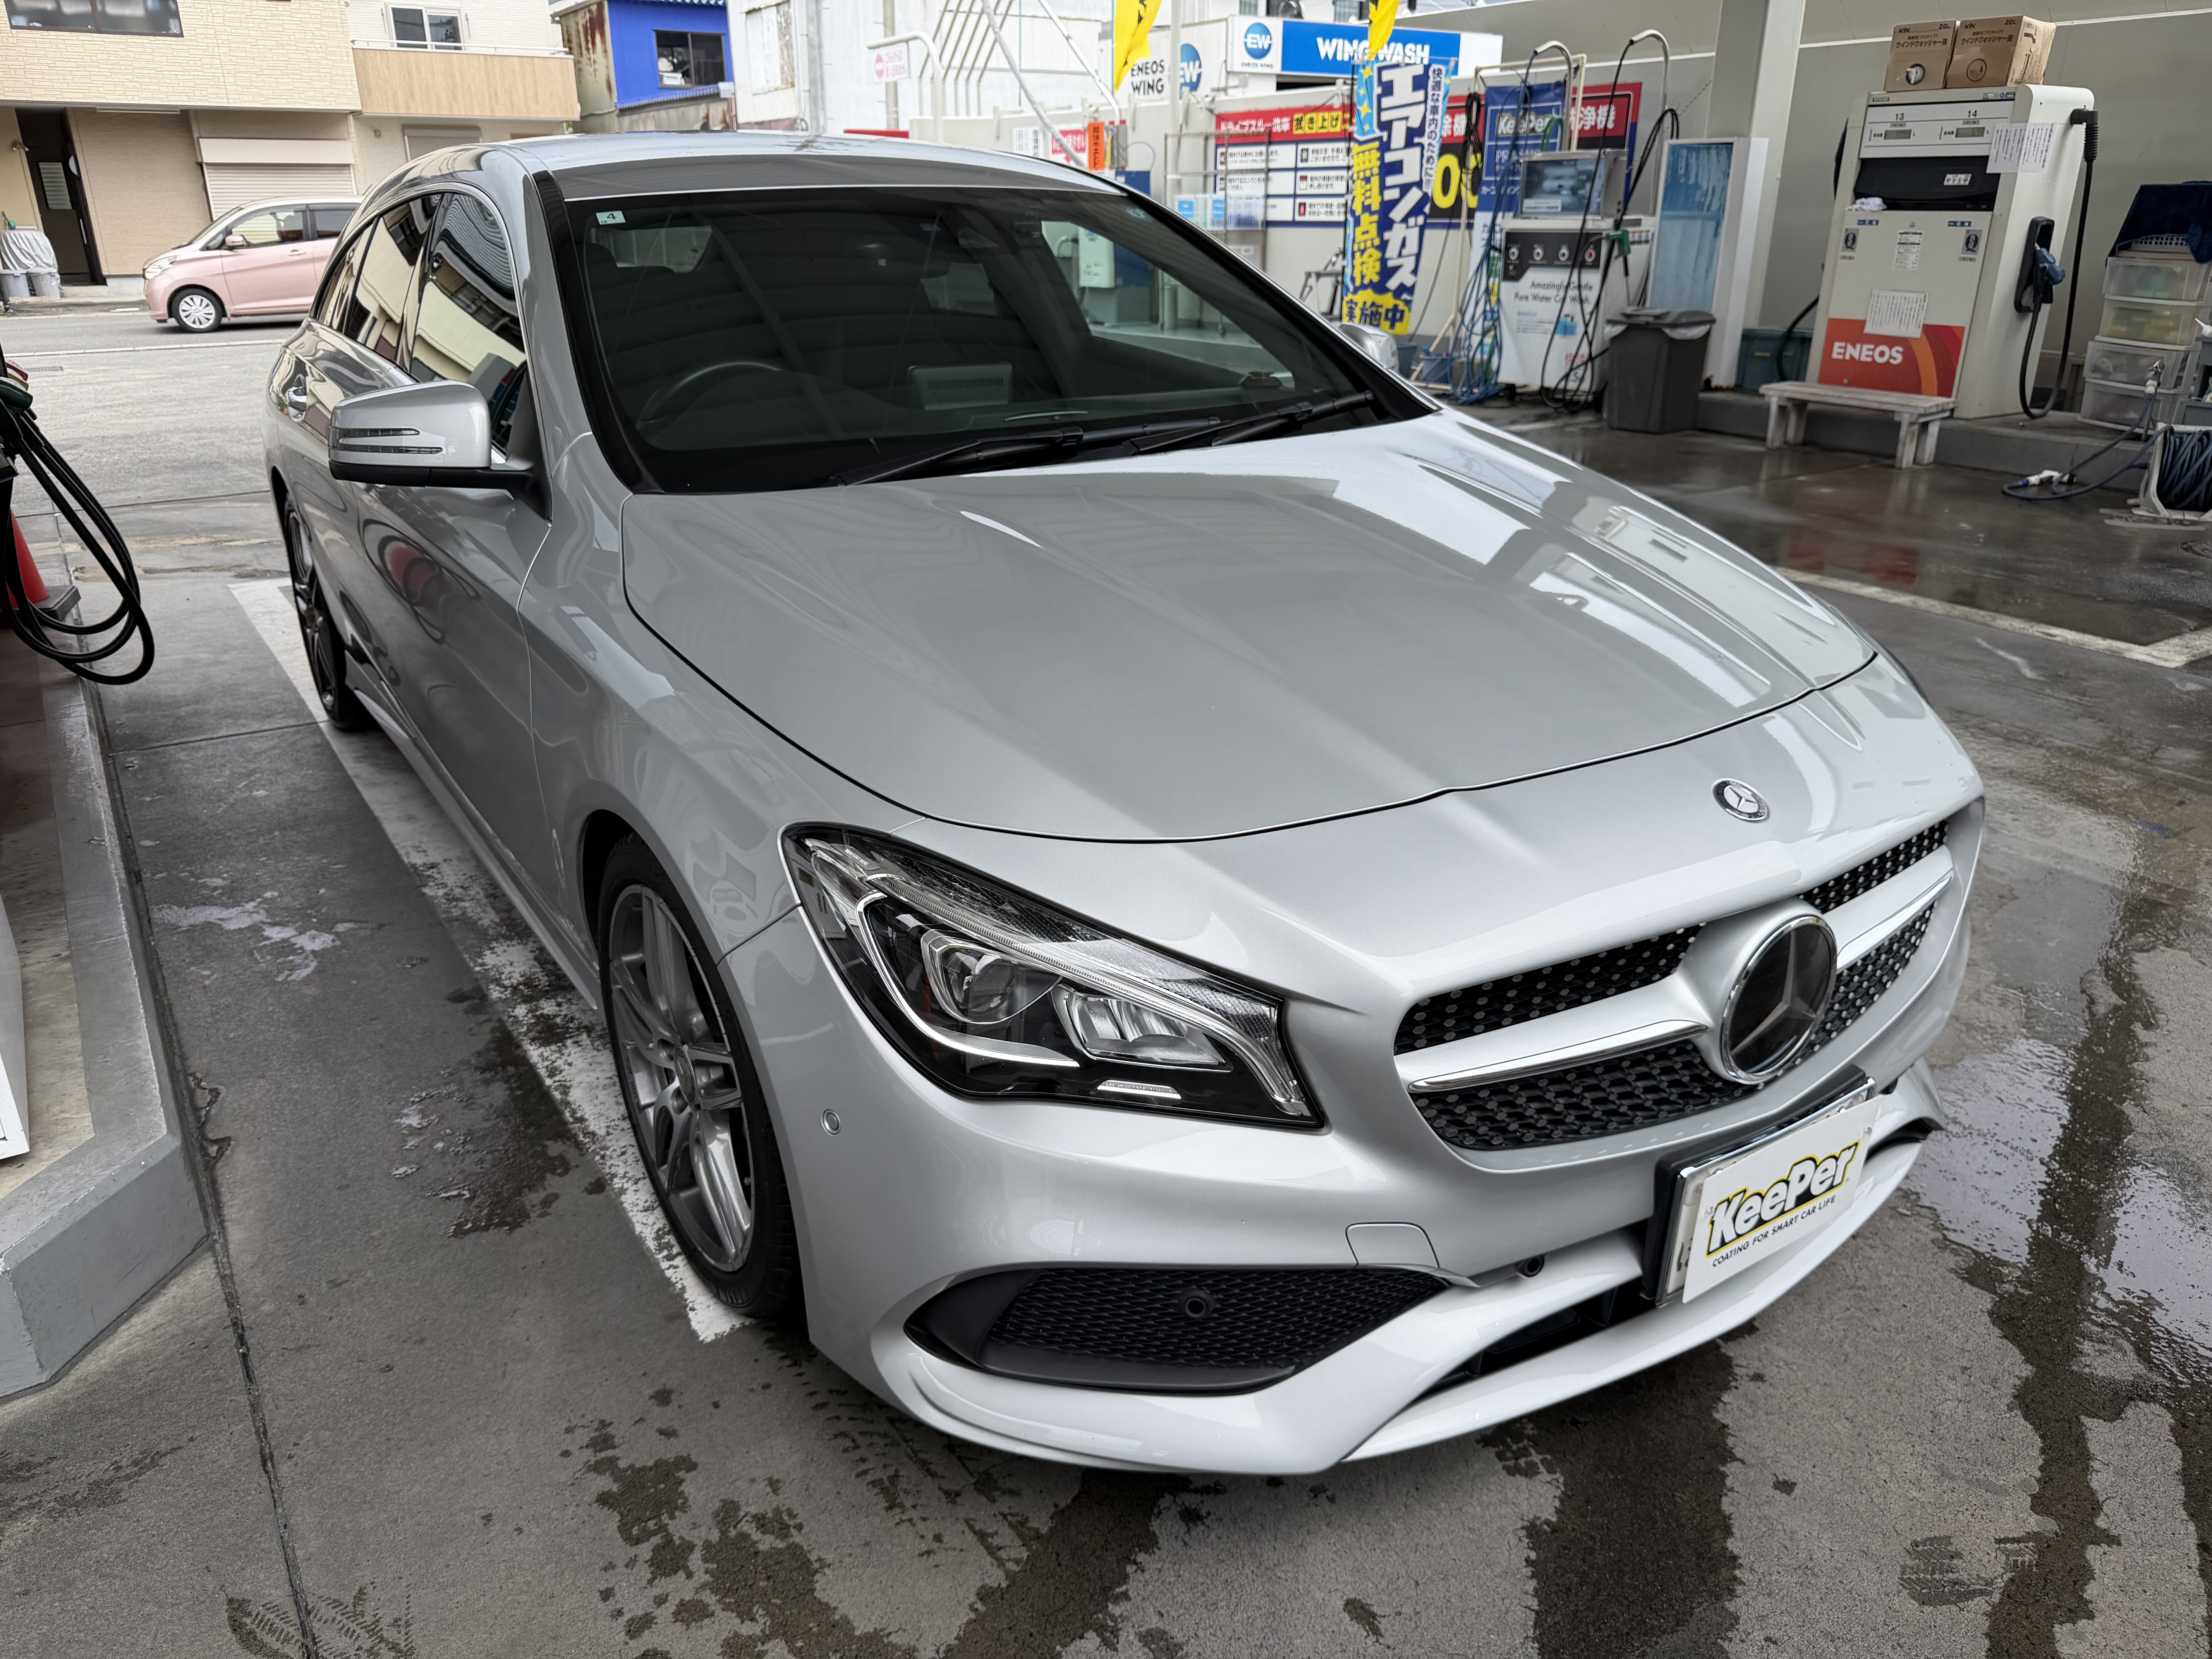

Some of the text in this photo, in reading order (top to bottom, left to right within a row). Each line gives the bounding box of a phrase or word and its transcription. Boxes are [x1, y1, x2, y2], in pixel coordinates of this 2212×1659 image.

[1317, 37, 1430, 64] WING WASH
[1131, 59, 1164, 77] ENEOS
[1131, 78, 1164, 96] WING
[1895, 113, 1904, 121] 13
[1967, 110, 1977, 118] 14
[1381, 64, 1425, 291] エアコンガス
[1352, 141, 1382, 287] 無料点検
[1530, 292, 1553, 303] Water
[1346, 299, 1405, 330] 実施中
[1831, 341, 1904, 365] ENEOS
[1706, 1140, 1860, 1258] KeePer
[1712, 1241, 1750, 1267] COATING
[1752, 1231, 1769, 1245] FOR
[1771, 1215, 1799, 1236] SMART
[1801, 1206, 1816, 1220] CAR
[1818, 1195, 1836, 1211] LIFE
